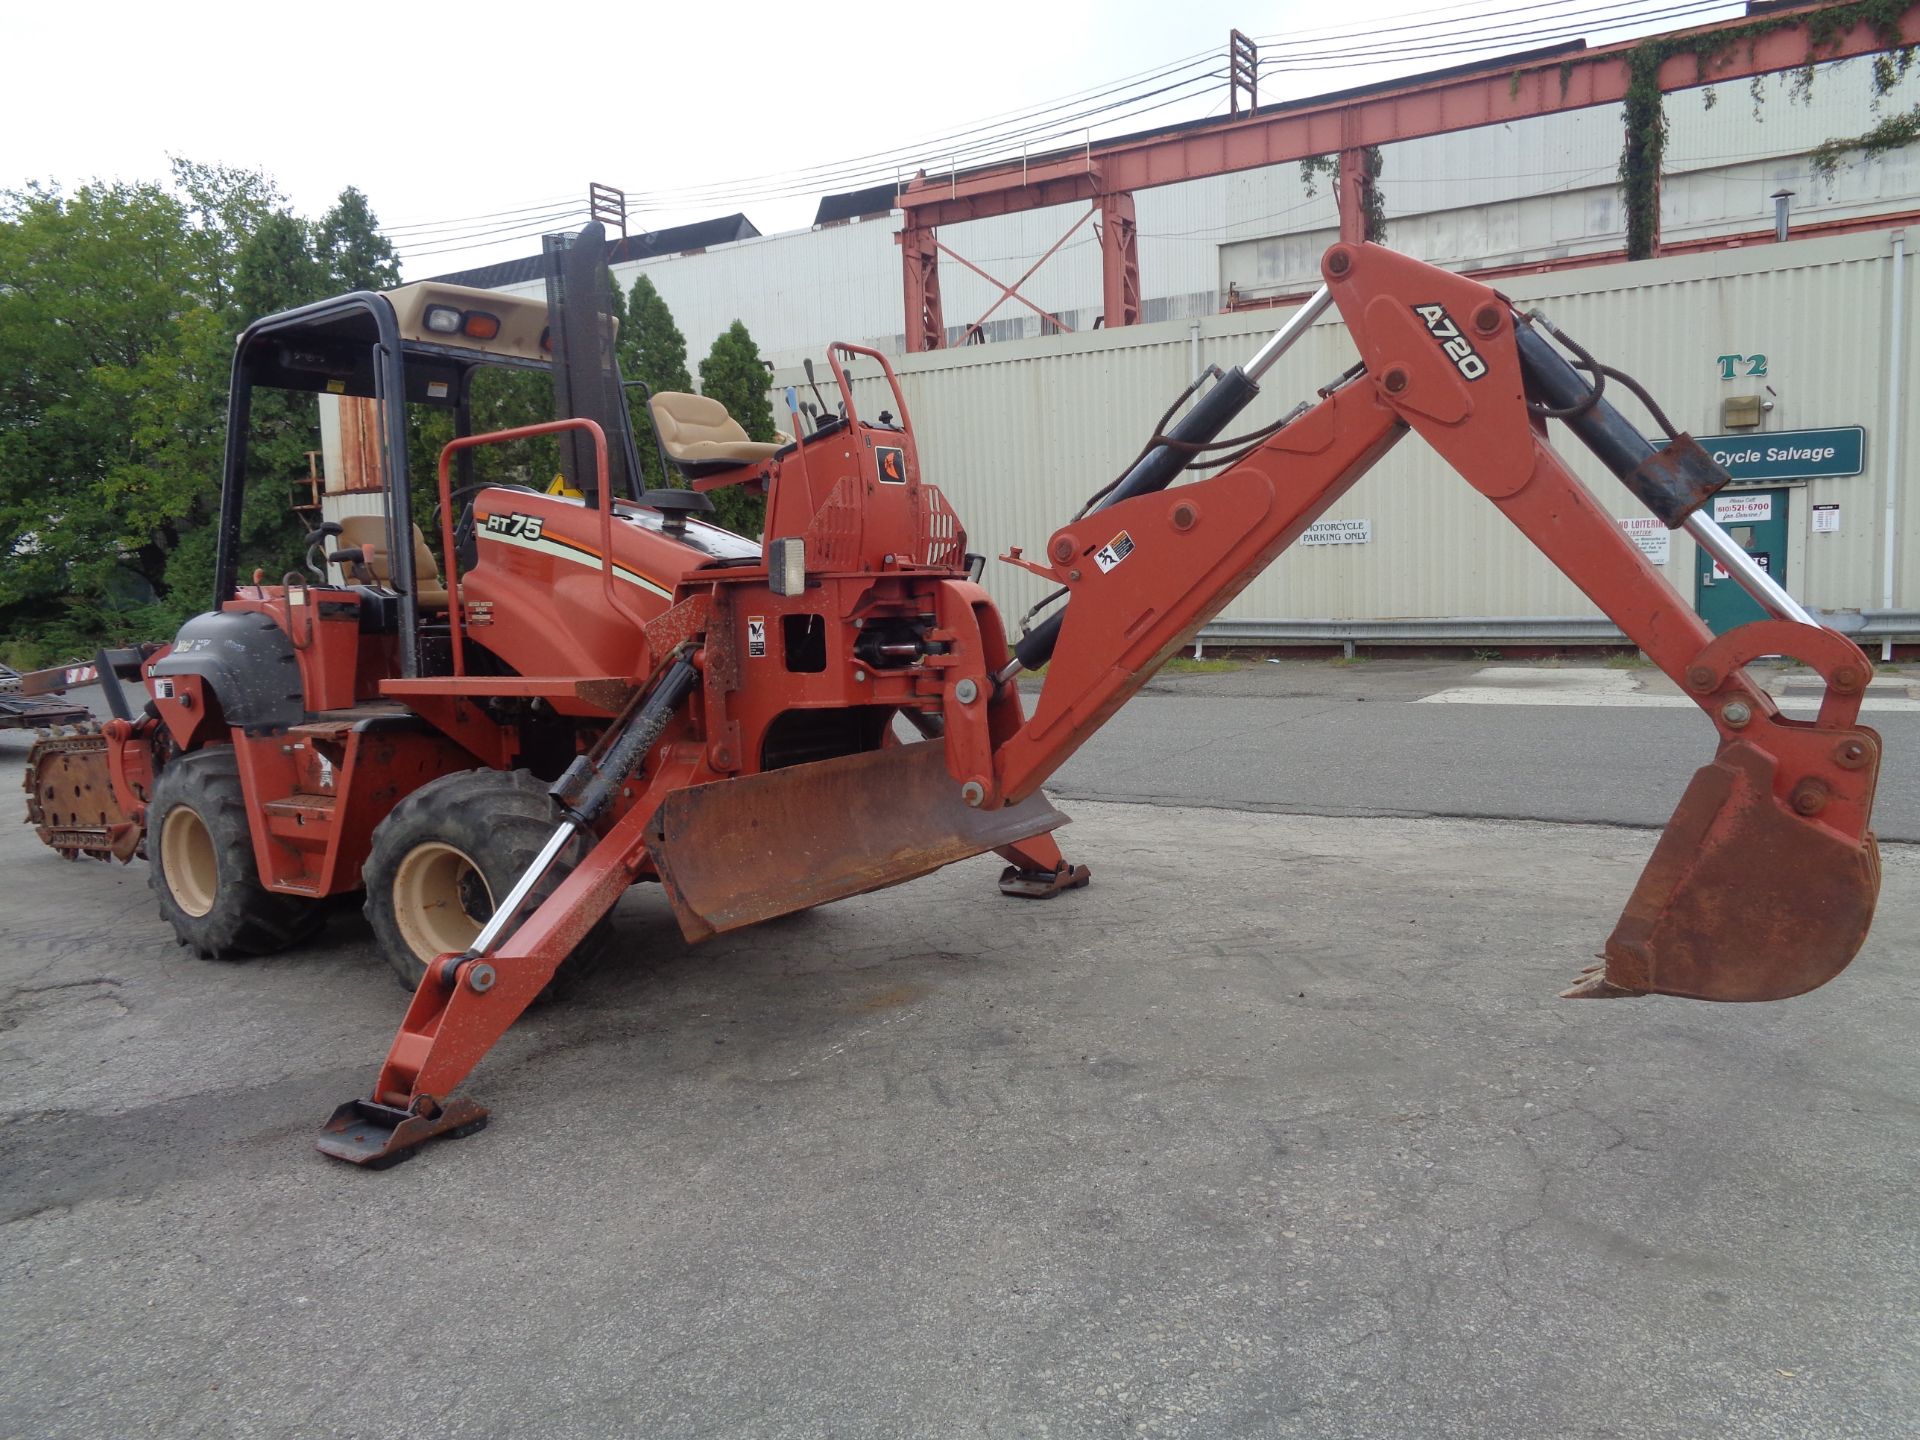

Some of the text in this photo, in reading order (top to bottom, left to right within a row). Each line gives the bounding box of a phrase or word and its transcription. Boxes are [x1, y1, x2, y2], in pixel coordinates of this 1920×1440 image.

[1415, 305, 1486, 380] A720
[1712, 446, 1835, 467] Cycle Salvage
[487, 514, 543, 539] RT75
[1632, 519, 1666, 528] LOITERIN
[1303, 532, 1367, 541] PARKING ONLY
